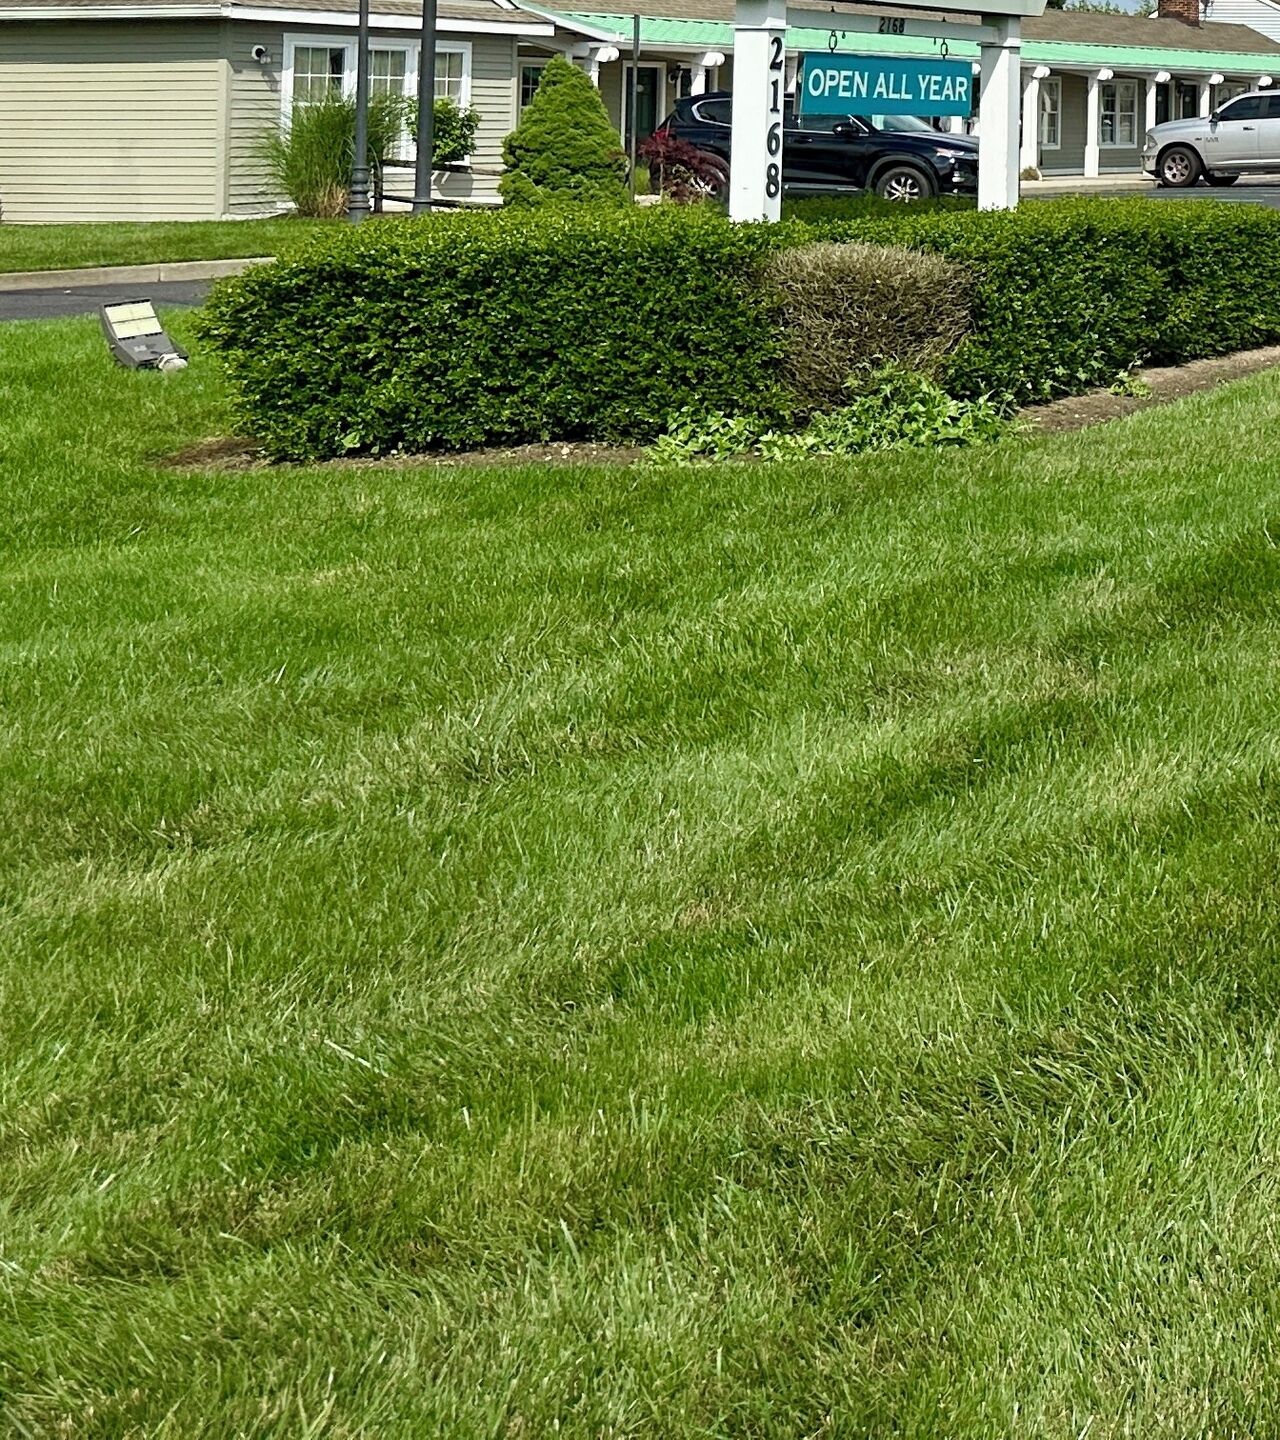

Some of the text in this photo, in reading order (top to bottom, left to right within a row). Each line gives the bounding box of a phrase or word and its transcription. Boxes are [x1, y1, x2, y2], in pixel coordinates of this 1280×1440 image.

[879, 16, 906, 34] 2168
[808, 68, 968, 102] OPEN ALL YEAR
[765, 36, 784, 199] 2168
